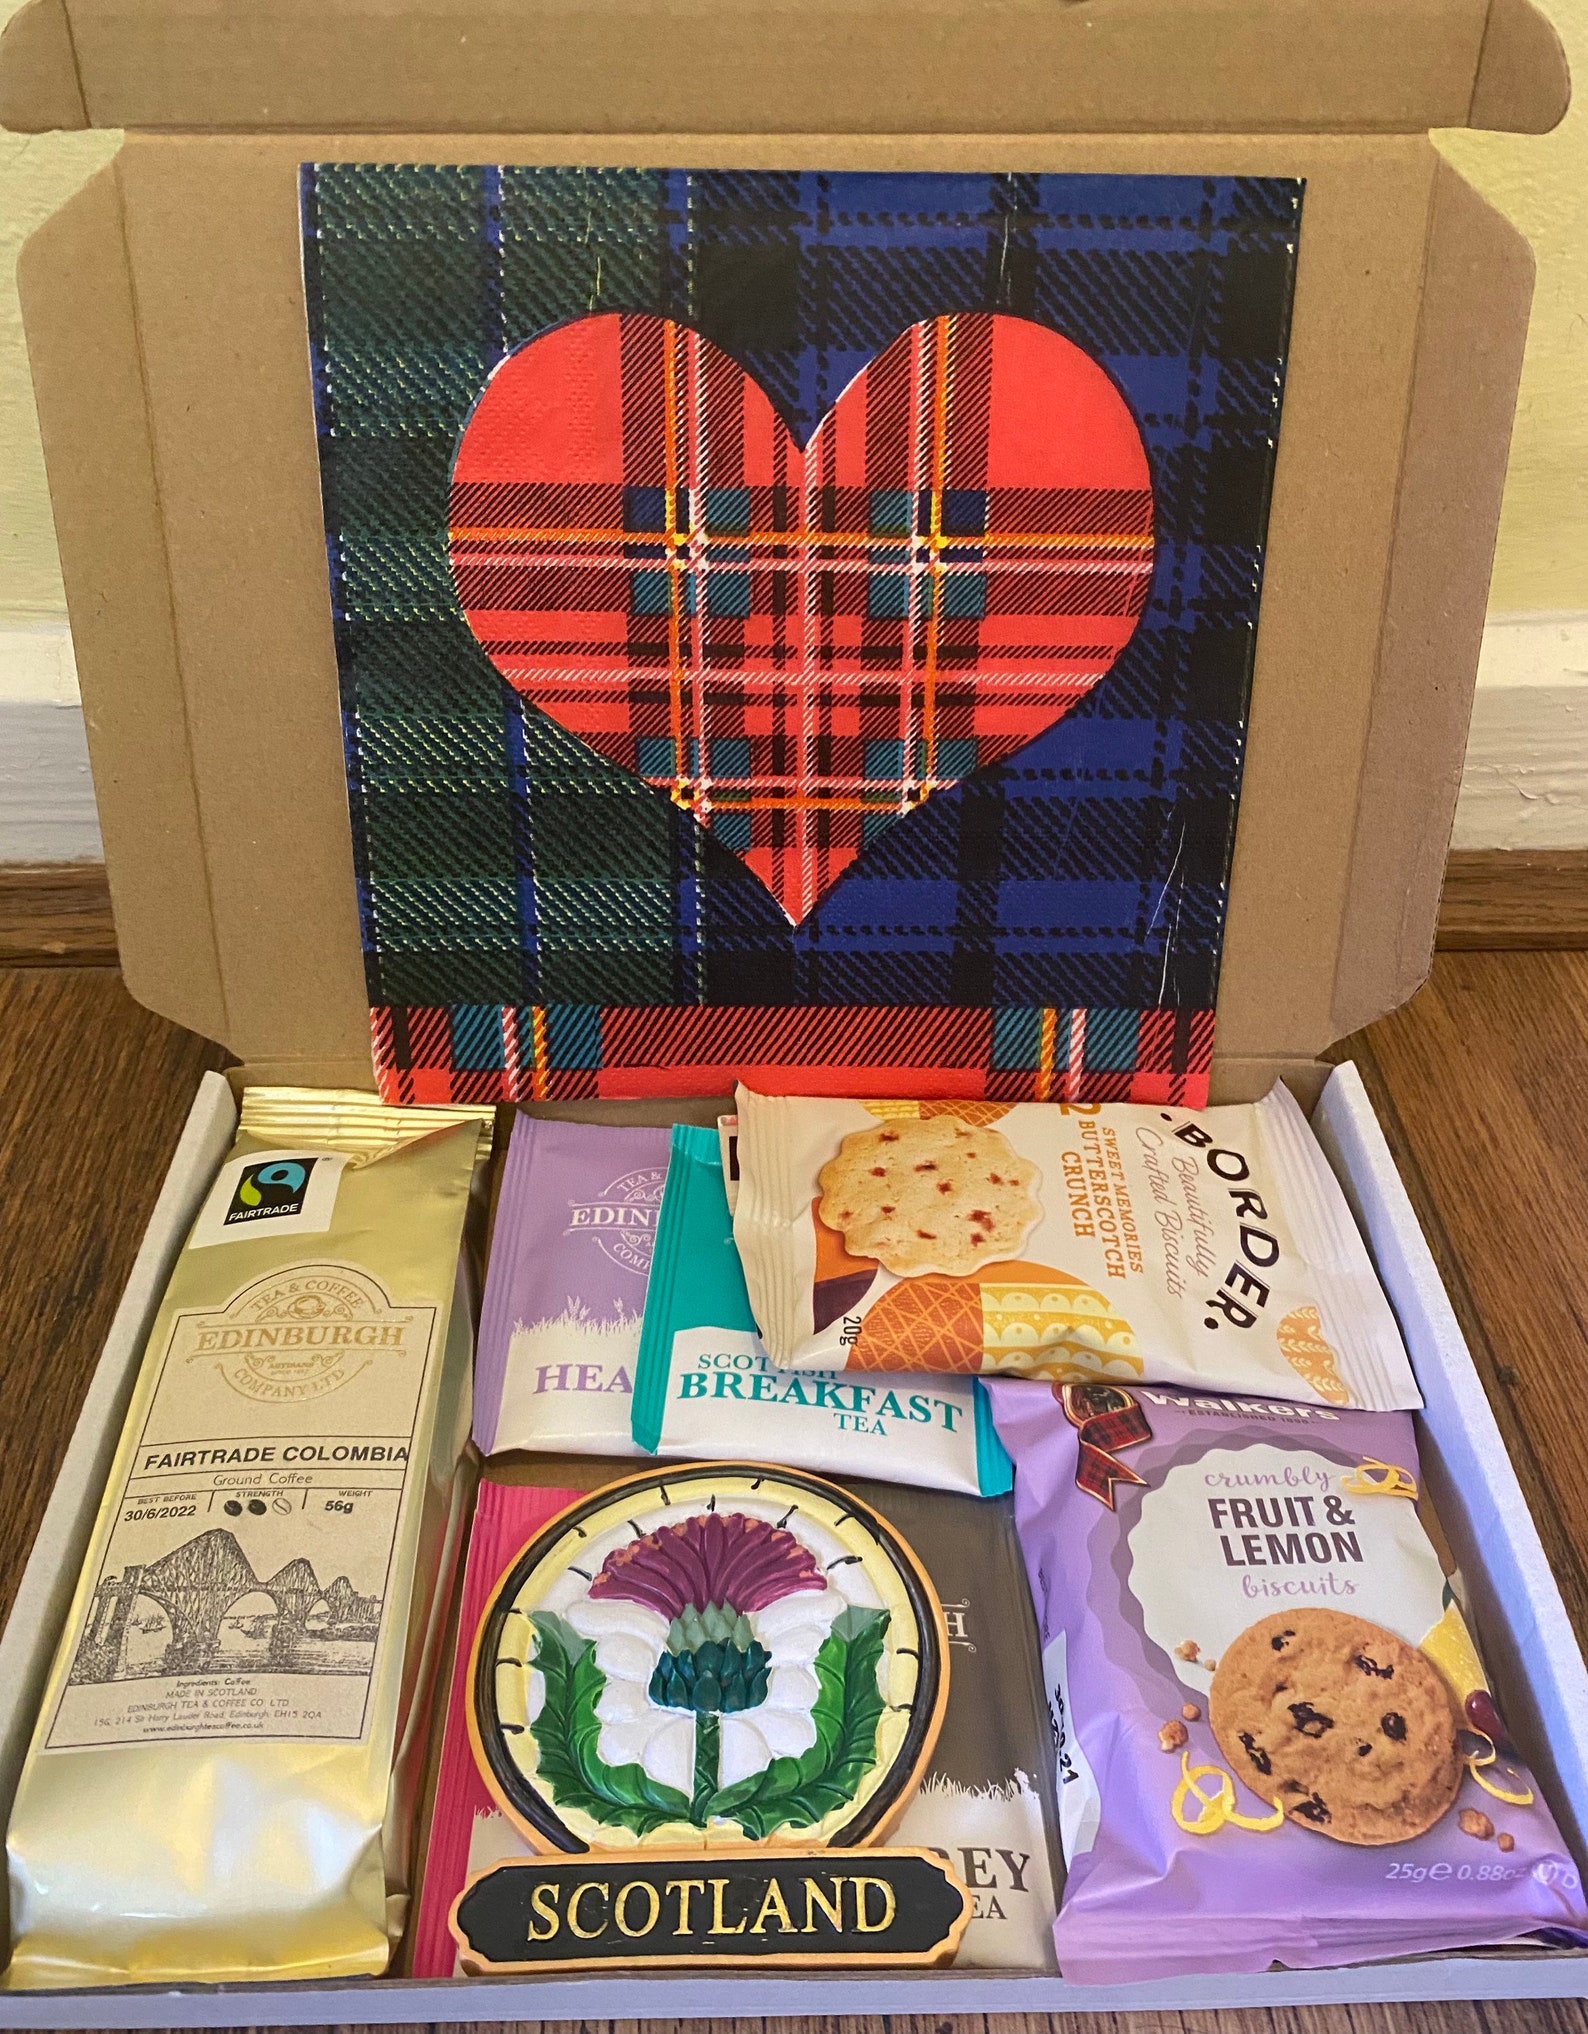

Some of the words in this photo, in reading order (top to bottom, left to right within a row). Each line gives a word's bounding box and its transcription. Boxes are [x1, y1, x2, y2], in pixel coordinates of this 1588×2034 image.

[1135, 1127, 1177, 1207] Crafted
[616, 1174, 648, 1192] TEA
[651, 1171, 662, 1180] &
[1061, 1151, 1095, 1238] CRUNCH
[228, 1203, 299, 1222] FAIRTRADE
[1078, 1120, 1126, 1279] BUTTERSCOTCH
[1102, 1127, 1123, 1180] SWEET
[1114, 1184, 1144, 1274] MEMORIES
[1171, 1156, 1217, 1279] Beautifully
[1154, 1210, 1187, 1299] Biscuits
[251, 1290, 284, 1312] TEA
[289, 1283, 300, 1292] &
[305, 1279, 362, 1309] COFFEE
[196, 1326, 405, 1350] EDINBURGH
[839, 1316, 862, 1346] 20g
[698, 1353, 838, 1379] SCOT
[234, 1368, 307, 1398] COMPANY
[312, 1369, 345, 1392] LTD
[532, 1364, 633, 1395] HEA
[677, 1372, 963, 1433] BREAKFAST
[1141, 1390, 1340, 1421] Walkers
[1188, 1409, 1276, 1421] ESTABLISHED
[833, 1413, 888, 1436] TEA
[144, 1447, 276, 1470] FAIRTRADE
[283, 1445, 409, 1462] COLOMBIA
[213, 1473, 262, 1487] Ground
[269, 1473, 313, 1485] Coffee
[1204, 1466, 1336, 1492] crumbly
[137, 1497, 160, 1505] BEST
[163, 1494, 197, 1502] BEFORE
[235, 1490, 284, 1498] STRENGTH
[338, 1489, 373, 1498] WEIGHT
[124, 1505, 197, 1522] 30/6/2022
[324, 1500, 354, 1514] 56g
[1208, 1496, 1316, 1529] FRUIT
[1323, 1495, 1356, 1526] &
[1220, 1531, 1363, 1566] LEMON
[1242, 1572, 1360, 1598] biscuits
[165, 1690, 191, 1699] MADE
[194, 1689, 204, 1698] IN
[208, 1688, 257, 1697] SCOTLAND
[224, 1677, 251, 1686] Coffee
[127, 1701, 177, 1713] EDINBURGH
[181, 1700, 198, 1709] TEA
[202, 1700, 208, 1708] &
[212, 1699, 247, 1708] COFFEE
[270, 1699, 290, 1707] LTD
[274, 1710, 298, 1718] EH15
[302, 1710, 322, 1719] 2QA
[928, 1847, 1030, 1892] EY
[527, 1876, 897, 1942] SCOTLAND
